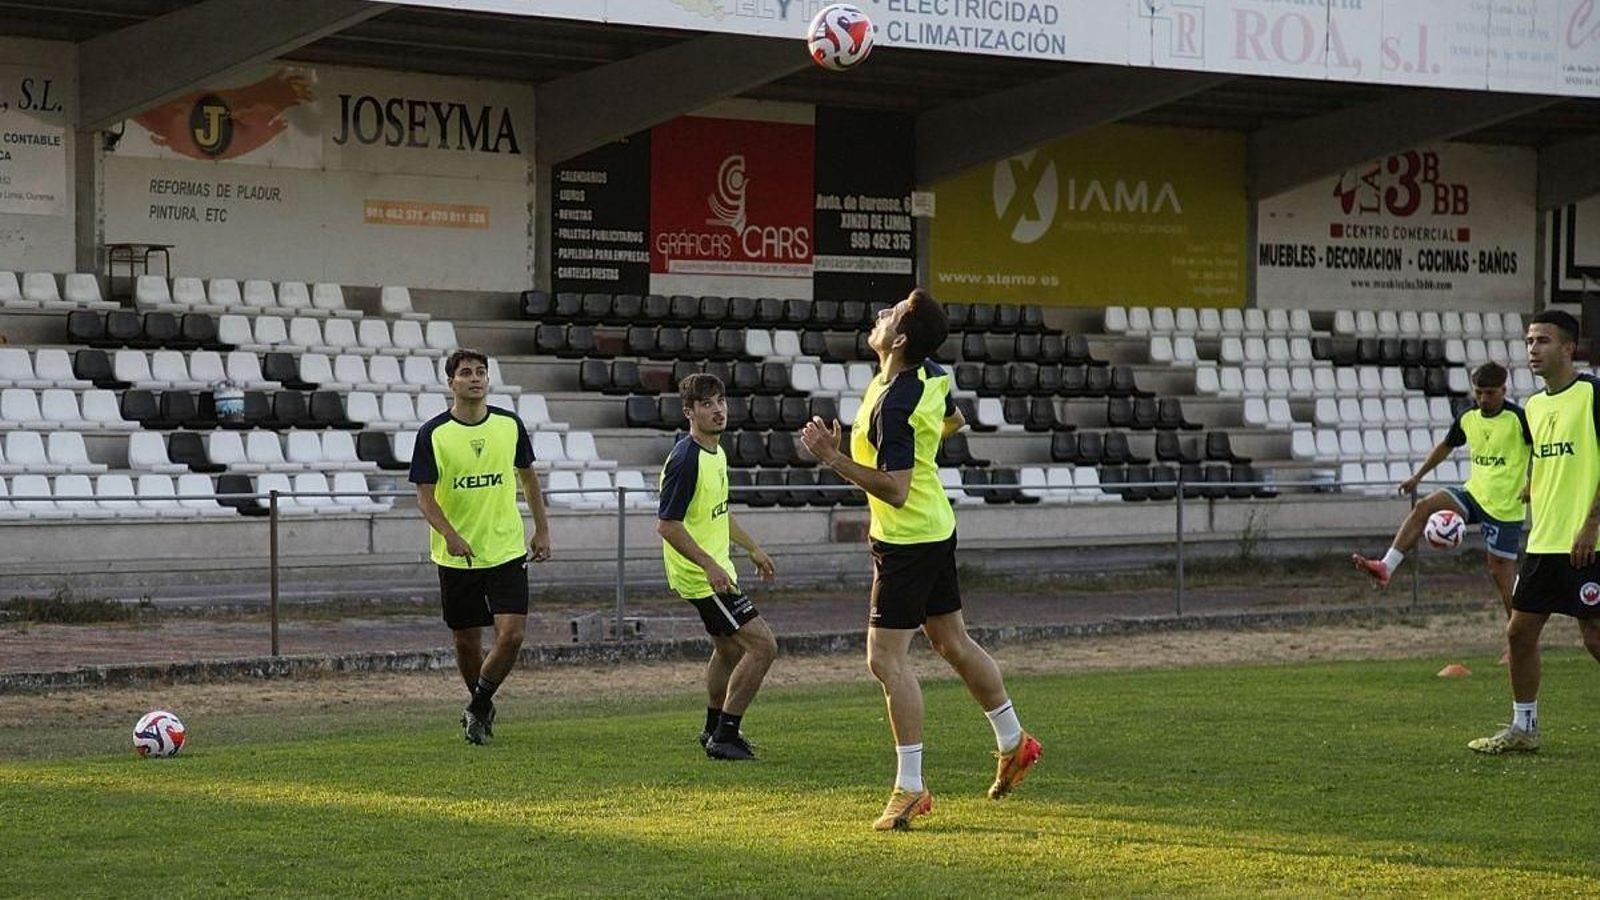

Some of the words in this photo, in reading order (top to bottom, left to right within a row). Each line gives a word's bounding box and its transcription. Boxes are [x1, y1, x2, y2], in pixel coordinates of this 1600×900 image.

[887, 0, 1058, 25] ELECTRICIDAD
[887, 21, 1066, 54] CLIMATIZACIÓN
[18, 78, 62, 112] S.L.
[194, 105, 229, 148] J
[332, 93, 521, 155] JOSEYMA
[3, 132, 61, 147] CONTABLE
[560, 170, 608, 184] CALENDARIOS
[1385, 149, 1422, 217] 3
[150, 179, 210, 198] REFORMAS
[216, 183, 232, 198] DE
[236, 184, 283, 202] PLADUR,
[559, 189, 585, 202] LIBROS
[844, 195, 858, 210] de
[149, 204, 200, 222] PINTURA,
[206, 207, 228, 222] ETC
[558, 208, 593, 221] REVISTAS
[840, 213, 869, 230] XINZO
[870, 214, 883, 230] DE
[884, 214, 912, 231] LIMA
[558, 228, 591, 240] FOLLETOS
[592, 229, 644, 244] PUBLICITARIOS
[742, 225, 809, 259] CARS
[872, 232, 892, 250] 462
[892, 233, 911, 251] 375
[1345, 224, 1390, 240] CENTRO
[1392, 226, 1456, 243] COMERCIAL
[595, 248, 613, 261] PARA
[613, 249, 650, 263] EMPRESAS
[1259, 243, 1317, 270] MUEBLES
[1325, 245, 1403, 272] DECORACION
[1417, 248, 1470, 274] COCINAS
[1478, 246, 1519, 275] BAÑOS
[558, 266, 591, 279] CARTELES
[938, 272, 1060, 288] www.xiama.es
